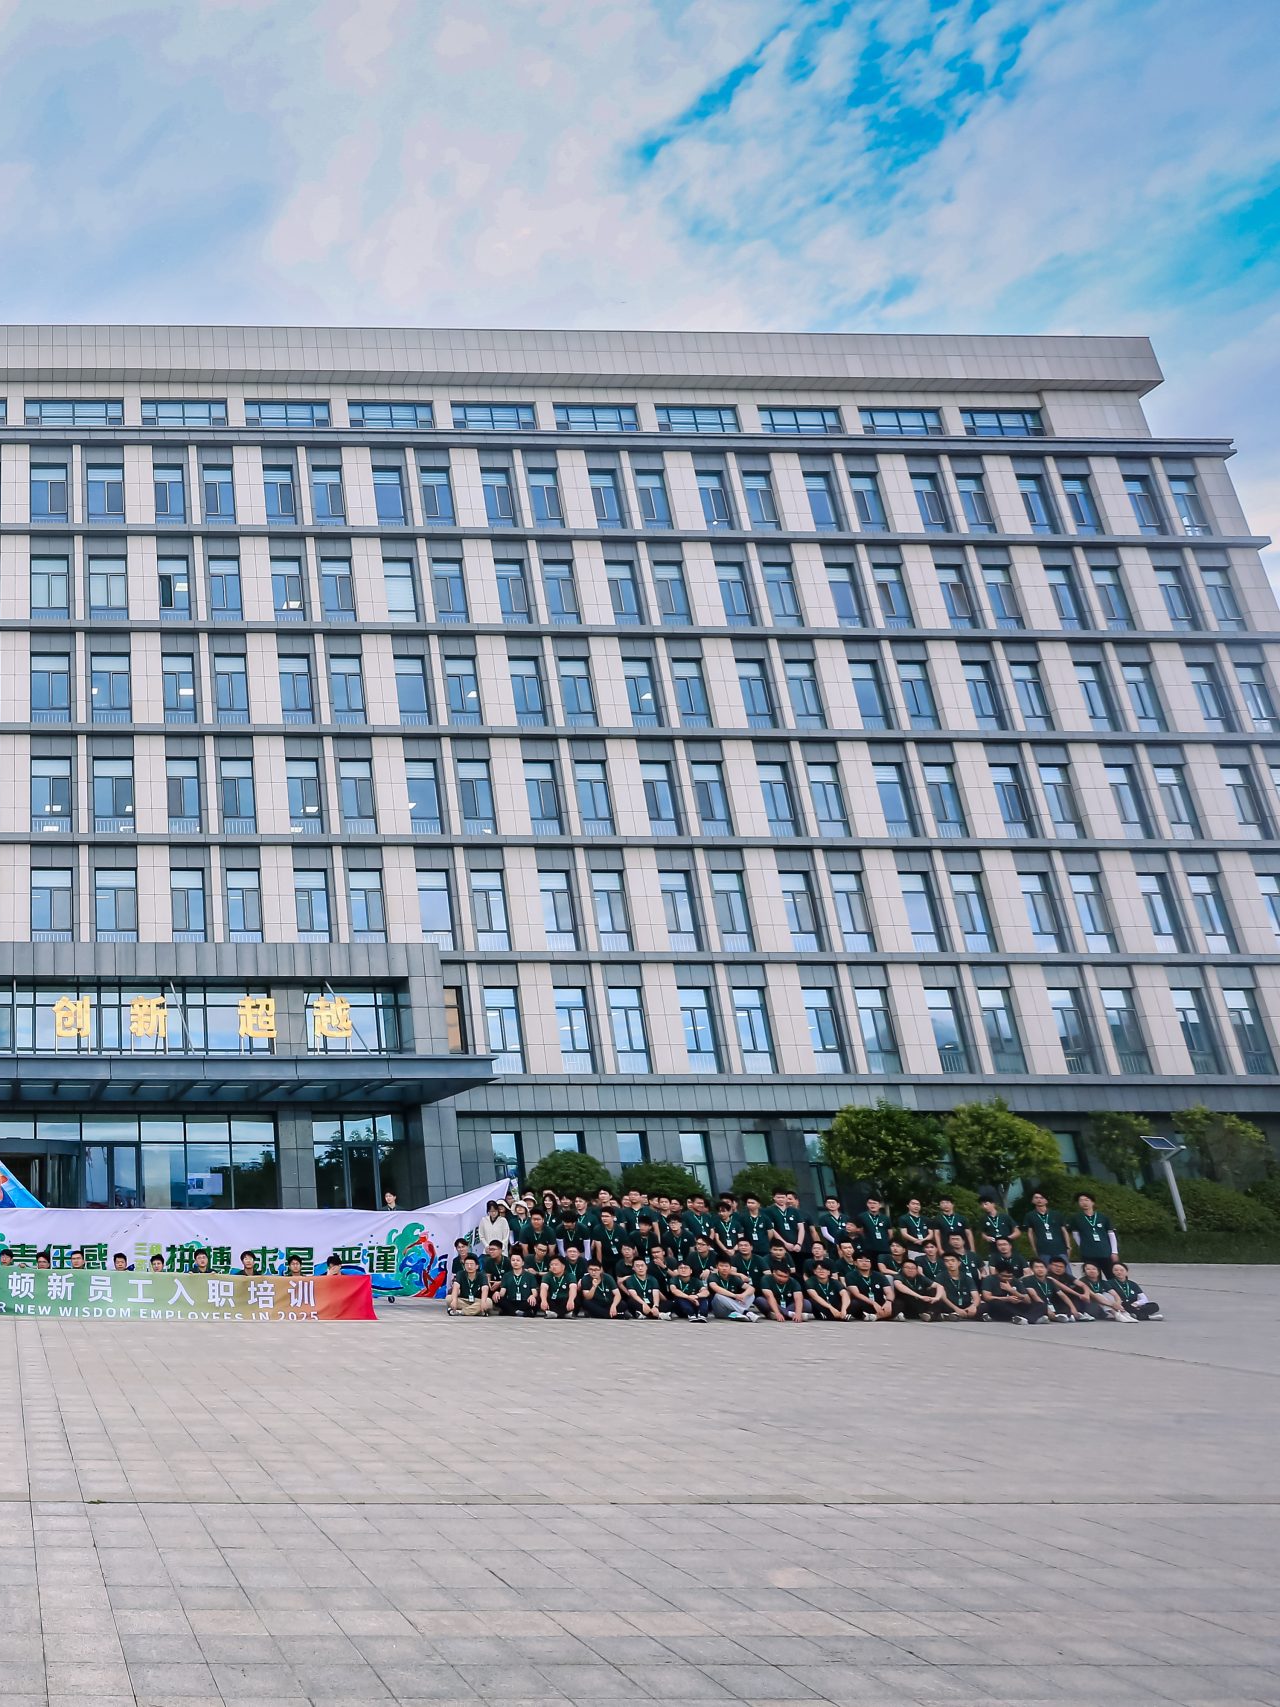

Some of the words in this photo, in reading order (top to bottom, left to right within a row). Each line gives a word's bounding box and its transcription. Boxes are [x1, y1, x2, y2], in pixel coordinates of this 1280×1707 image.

[52, 995, 168, 1038] 创新
[237, 996, 353, 1039] 超越
[14, 1303, 51, 1315] NEW
[59, 1306, 131, 1318] WISDOM
[139, 1308, 243, 1320] EMPLOYEES
[251, 1312, 270, 1320] IN
[277, 1311, 319, 1320] 2025
